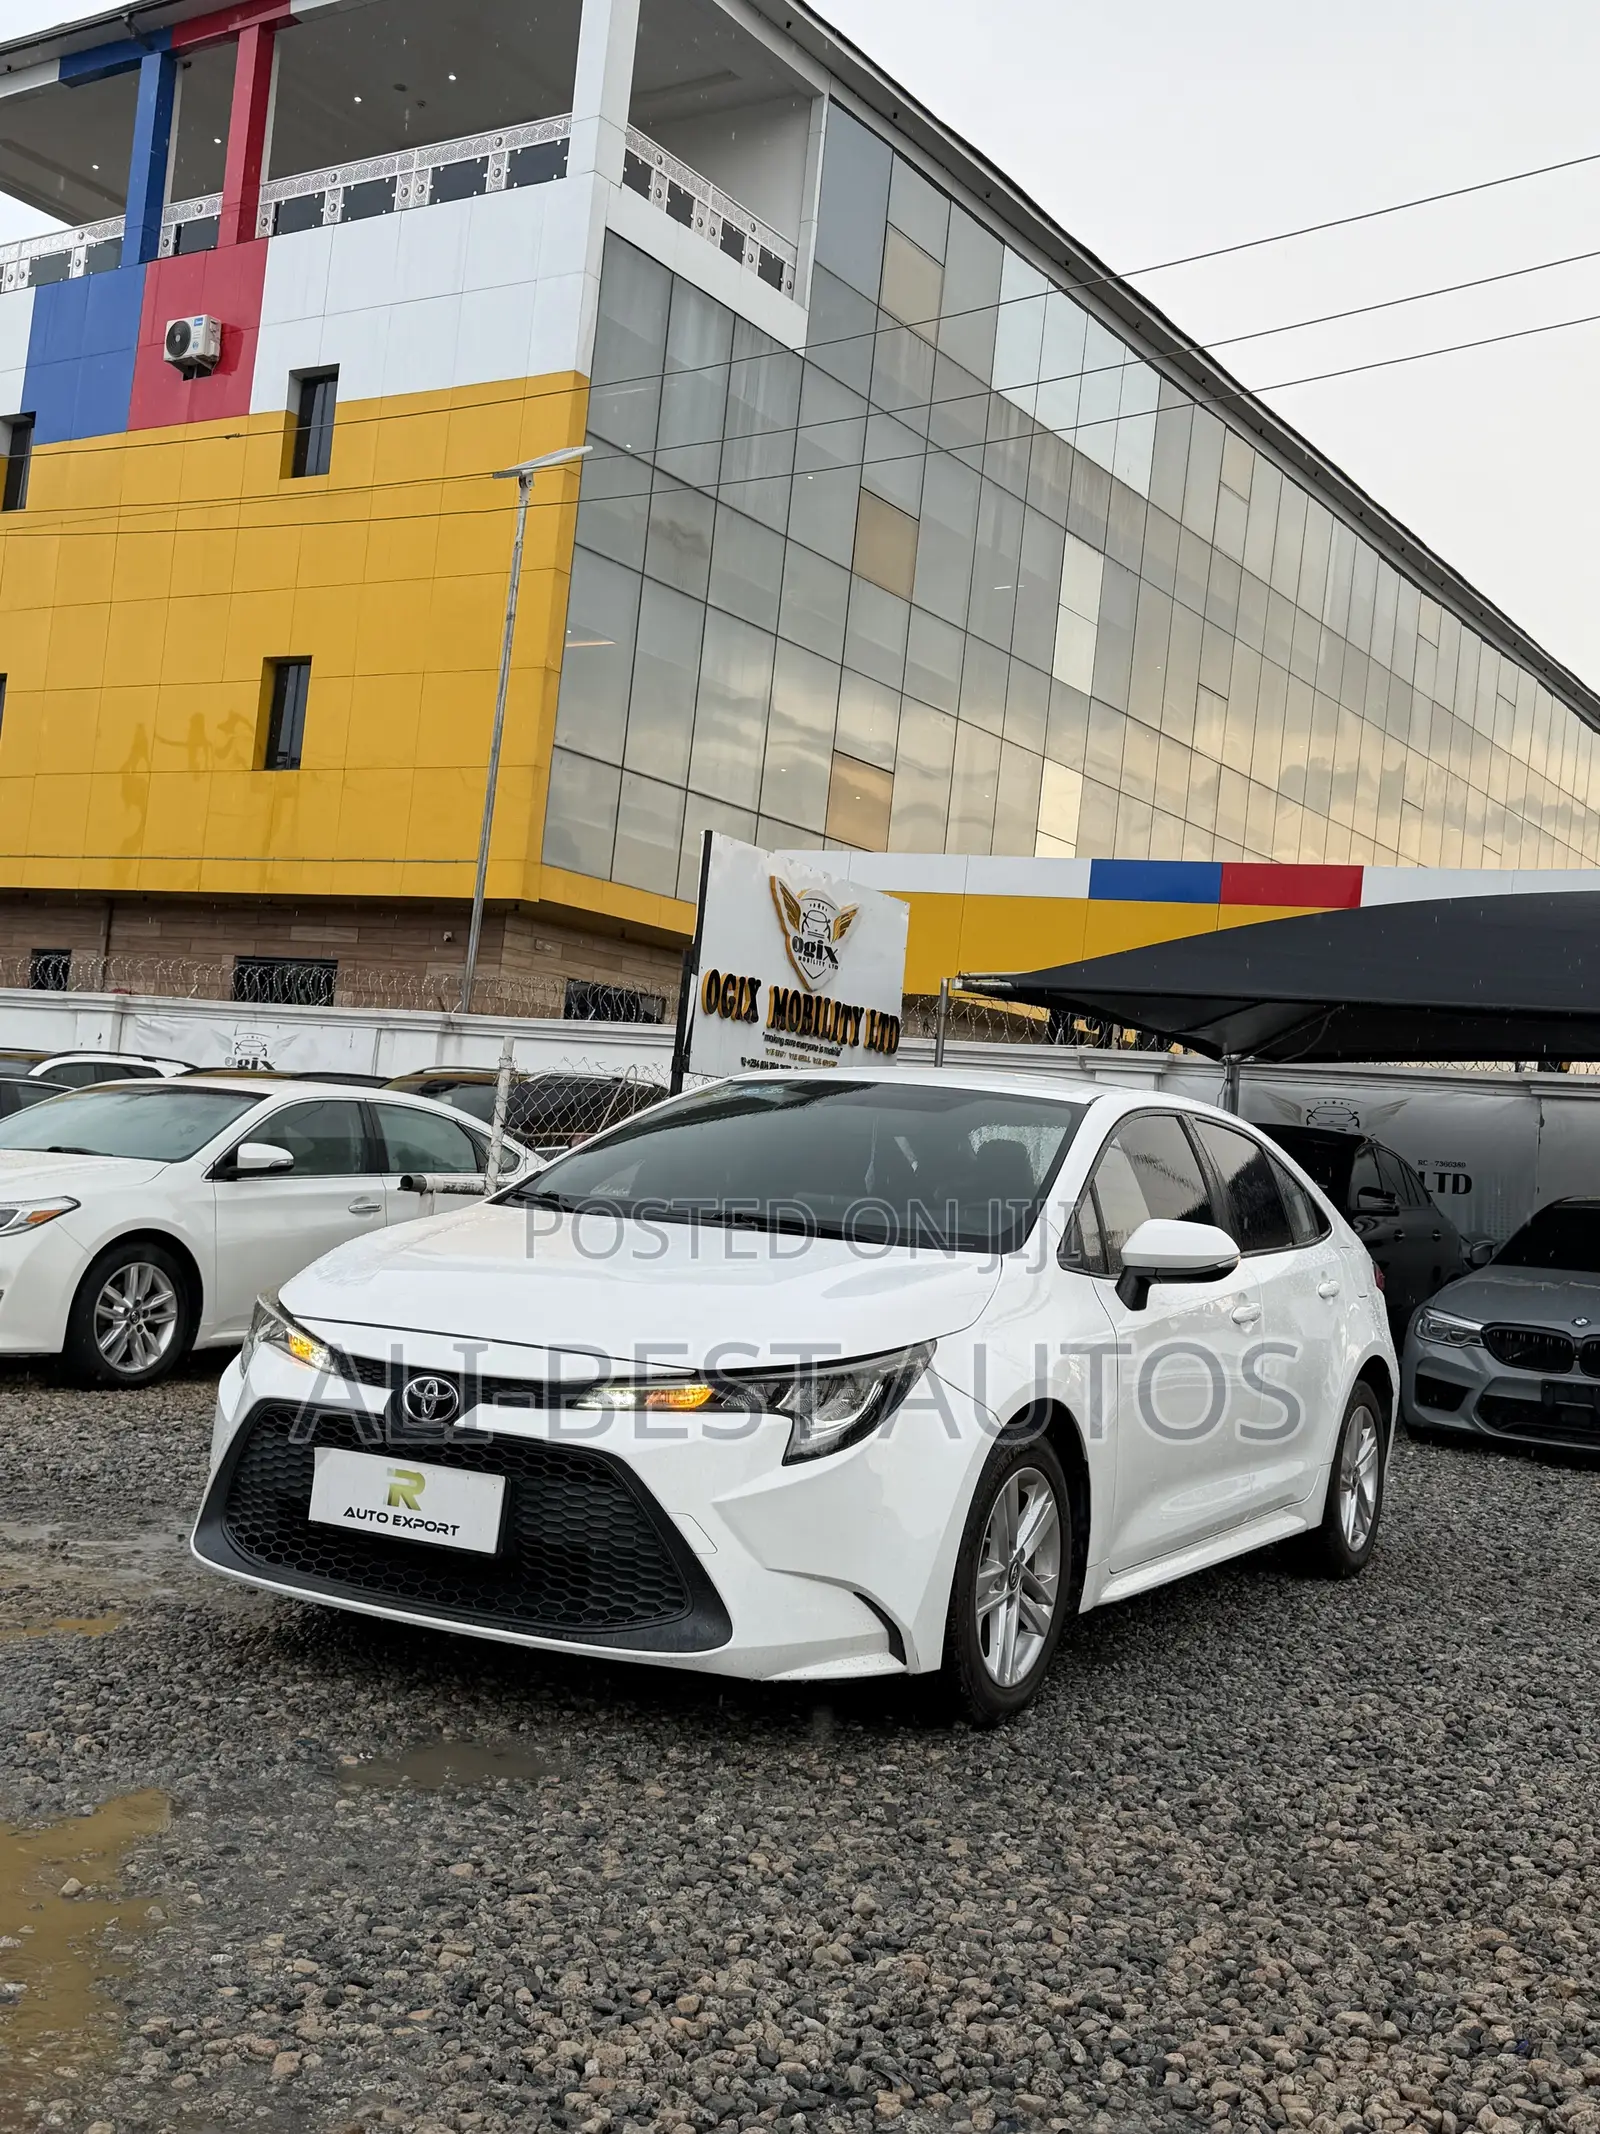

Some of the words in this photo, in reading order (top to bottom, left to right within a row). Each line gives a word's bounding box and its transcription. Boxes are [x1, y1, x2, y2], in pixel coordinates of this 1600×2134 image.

[702, 969, 761, 1023] OGIX
[766, 985, 864, 1047] MOBILITY
[863, 1008, 900, 1055] LTD
[1417, 1159, 1428, 1167] RC
[1418, 1171, 1472, 1195] LTD
[343, 1506, 389, 1524] AUTO
[392, 1514, 460, 1537] EXPORT
